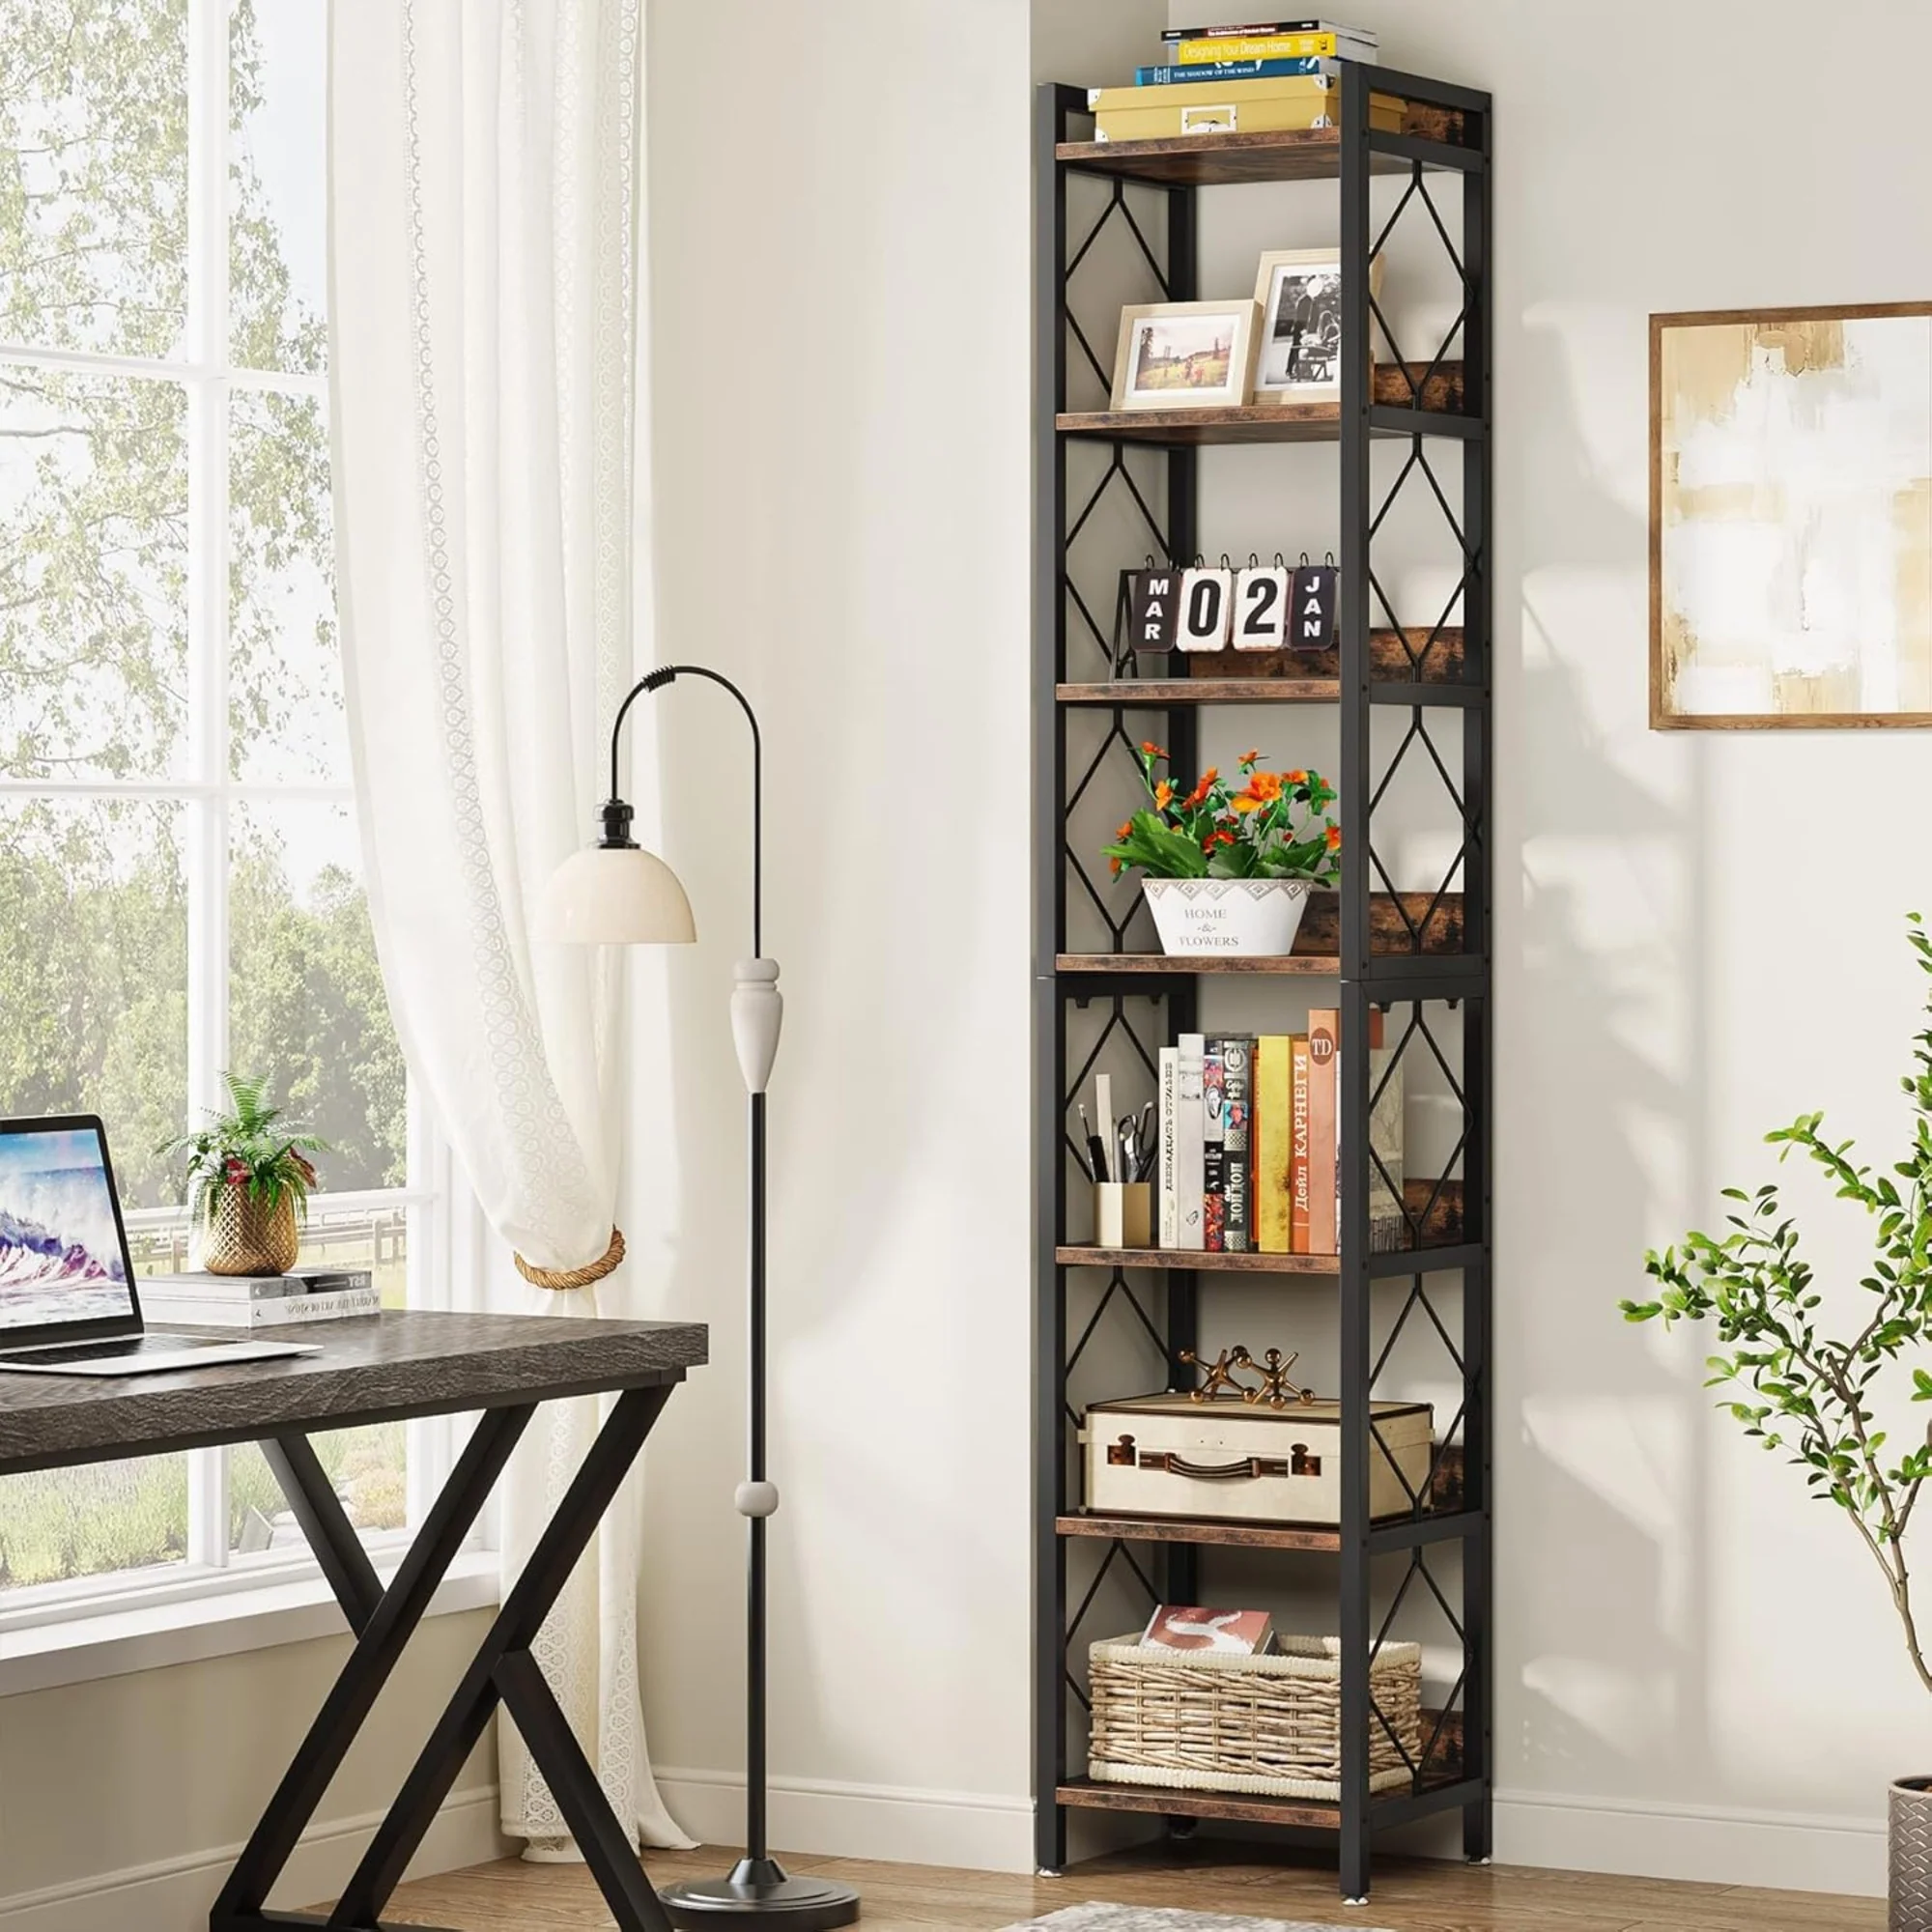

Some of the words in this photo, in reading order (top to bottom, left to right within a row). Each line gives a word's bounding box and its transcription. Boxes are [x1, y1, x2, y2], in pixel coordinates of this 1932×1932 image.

[1183, 43, 1221, 59] Designing
[1222, 42, 1239, 56] Your
[1240, 41, 1265, 54] Dream
[1267, 40, 1291, 52] Home
[1145, 580, 1169, 639] MAR
[1303, 576, 1322, 638] JAN
[1184, 909, 1227, 920] HOME
[1179, 935, 1239, 947] FLOWERS
[1311, 1037, 1333, 1056] TD
[1293, 1054, 1308, 1159] КАРНЕГИ
[1294, 1165, 1309, 1212] Дейл
